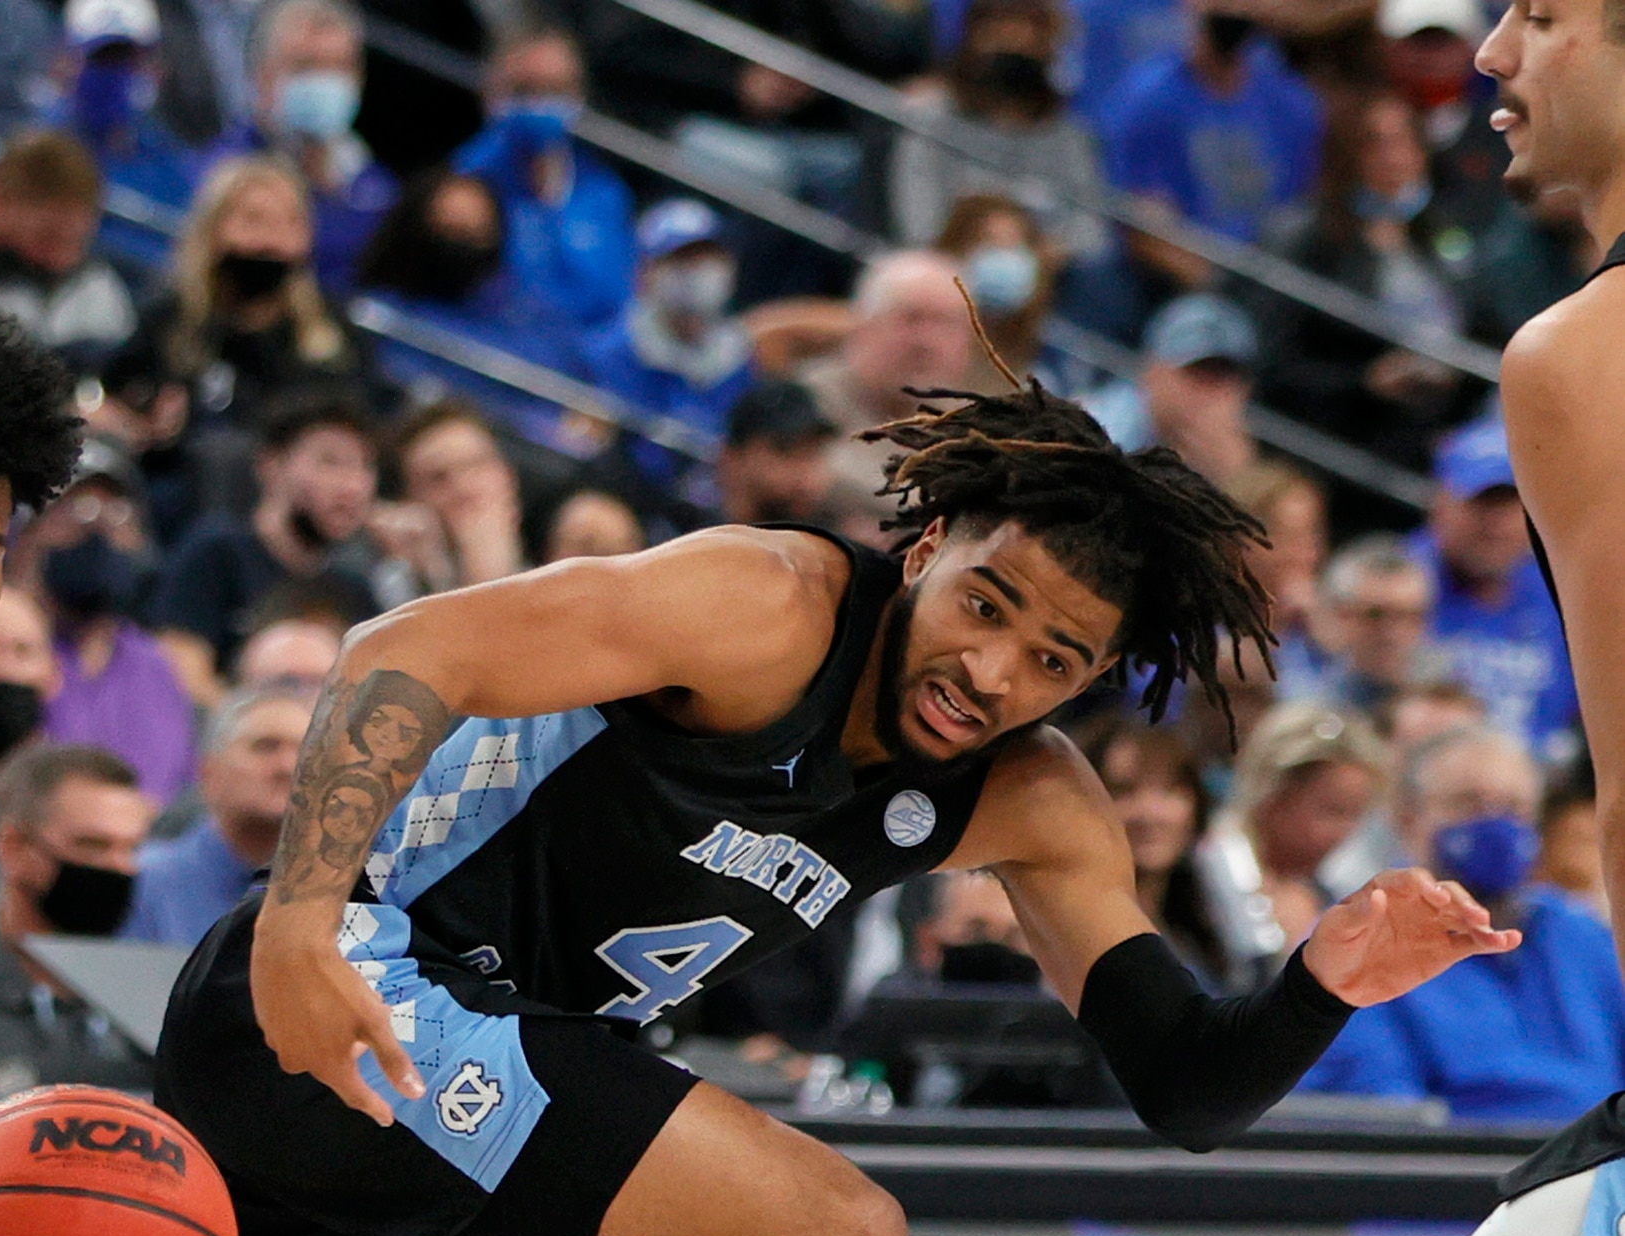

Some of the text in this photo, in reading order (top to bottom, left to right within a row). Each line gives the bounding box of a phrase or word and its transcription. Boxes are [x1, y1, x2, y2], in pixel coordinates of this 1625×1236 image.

[679, 820, 852, 930] NORTH
[593, 915, 755, 1027] 4
[30, 1117, 186, 1178] NCAA
